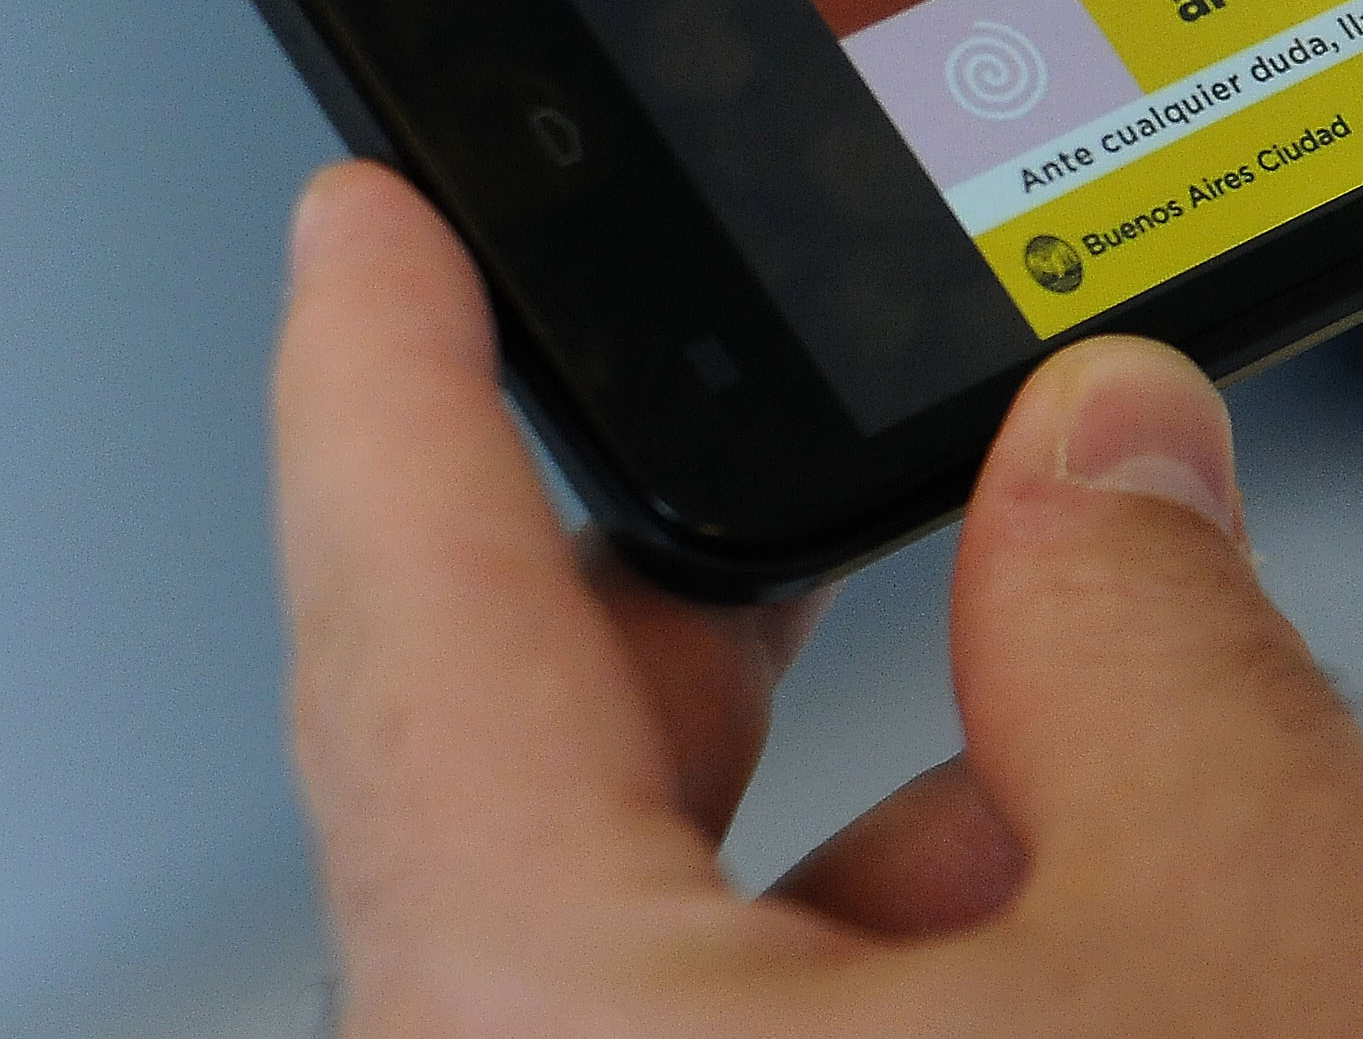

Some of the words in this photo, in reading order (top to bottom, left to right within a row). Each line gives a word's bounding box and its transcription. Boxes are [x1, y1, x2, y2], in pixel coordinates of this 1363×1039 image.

[1022, 148, 1094, 193] Ante
[1102, 75, 1241, 152] cualquier
[1251, 38, 1339, 82] duda,
[1082, 200, 1183, 256] Buenos
[1189, 166, 1255, 208] Aires
[1257, 114, 1351, 171] Ciudad
